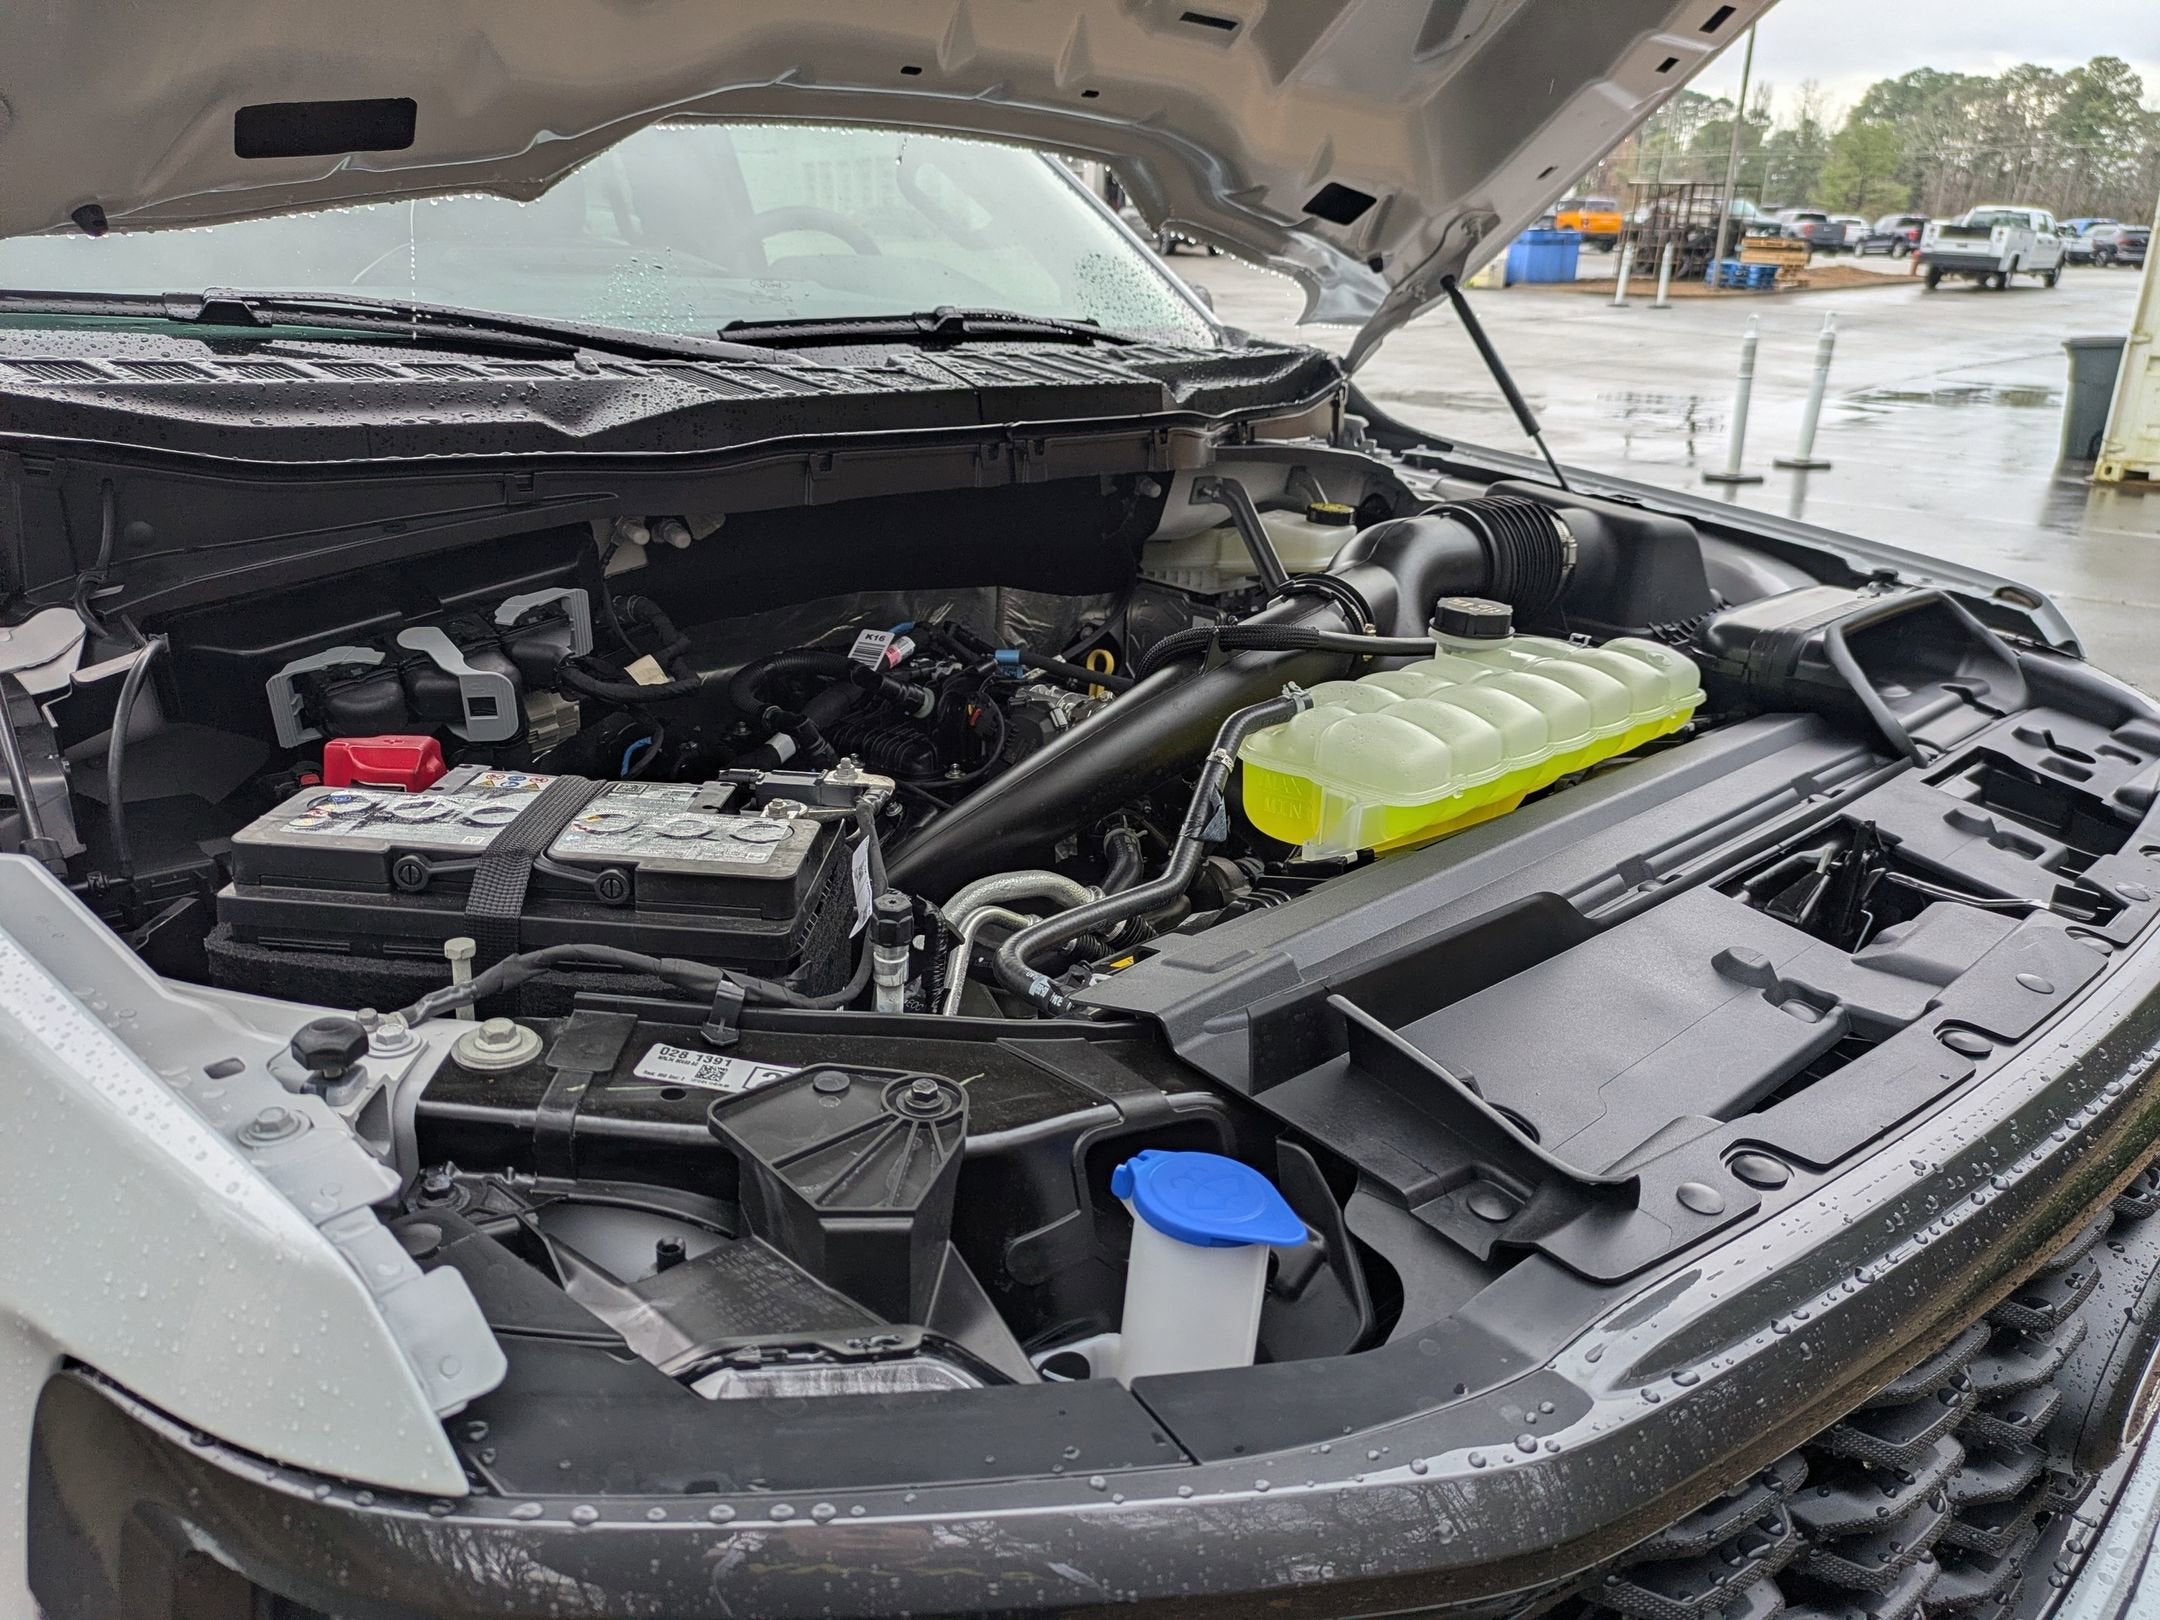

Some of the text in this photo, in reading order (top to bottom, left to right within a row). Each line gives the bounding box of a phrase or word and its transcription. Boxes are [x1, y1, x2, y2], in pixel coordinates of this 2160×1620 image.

[864, 633, 887, 642] K16
[659, 1046, 689, 1059] 028
[697, 1054, 732, 1067] 1391
